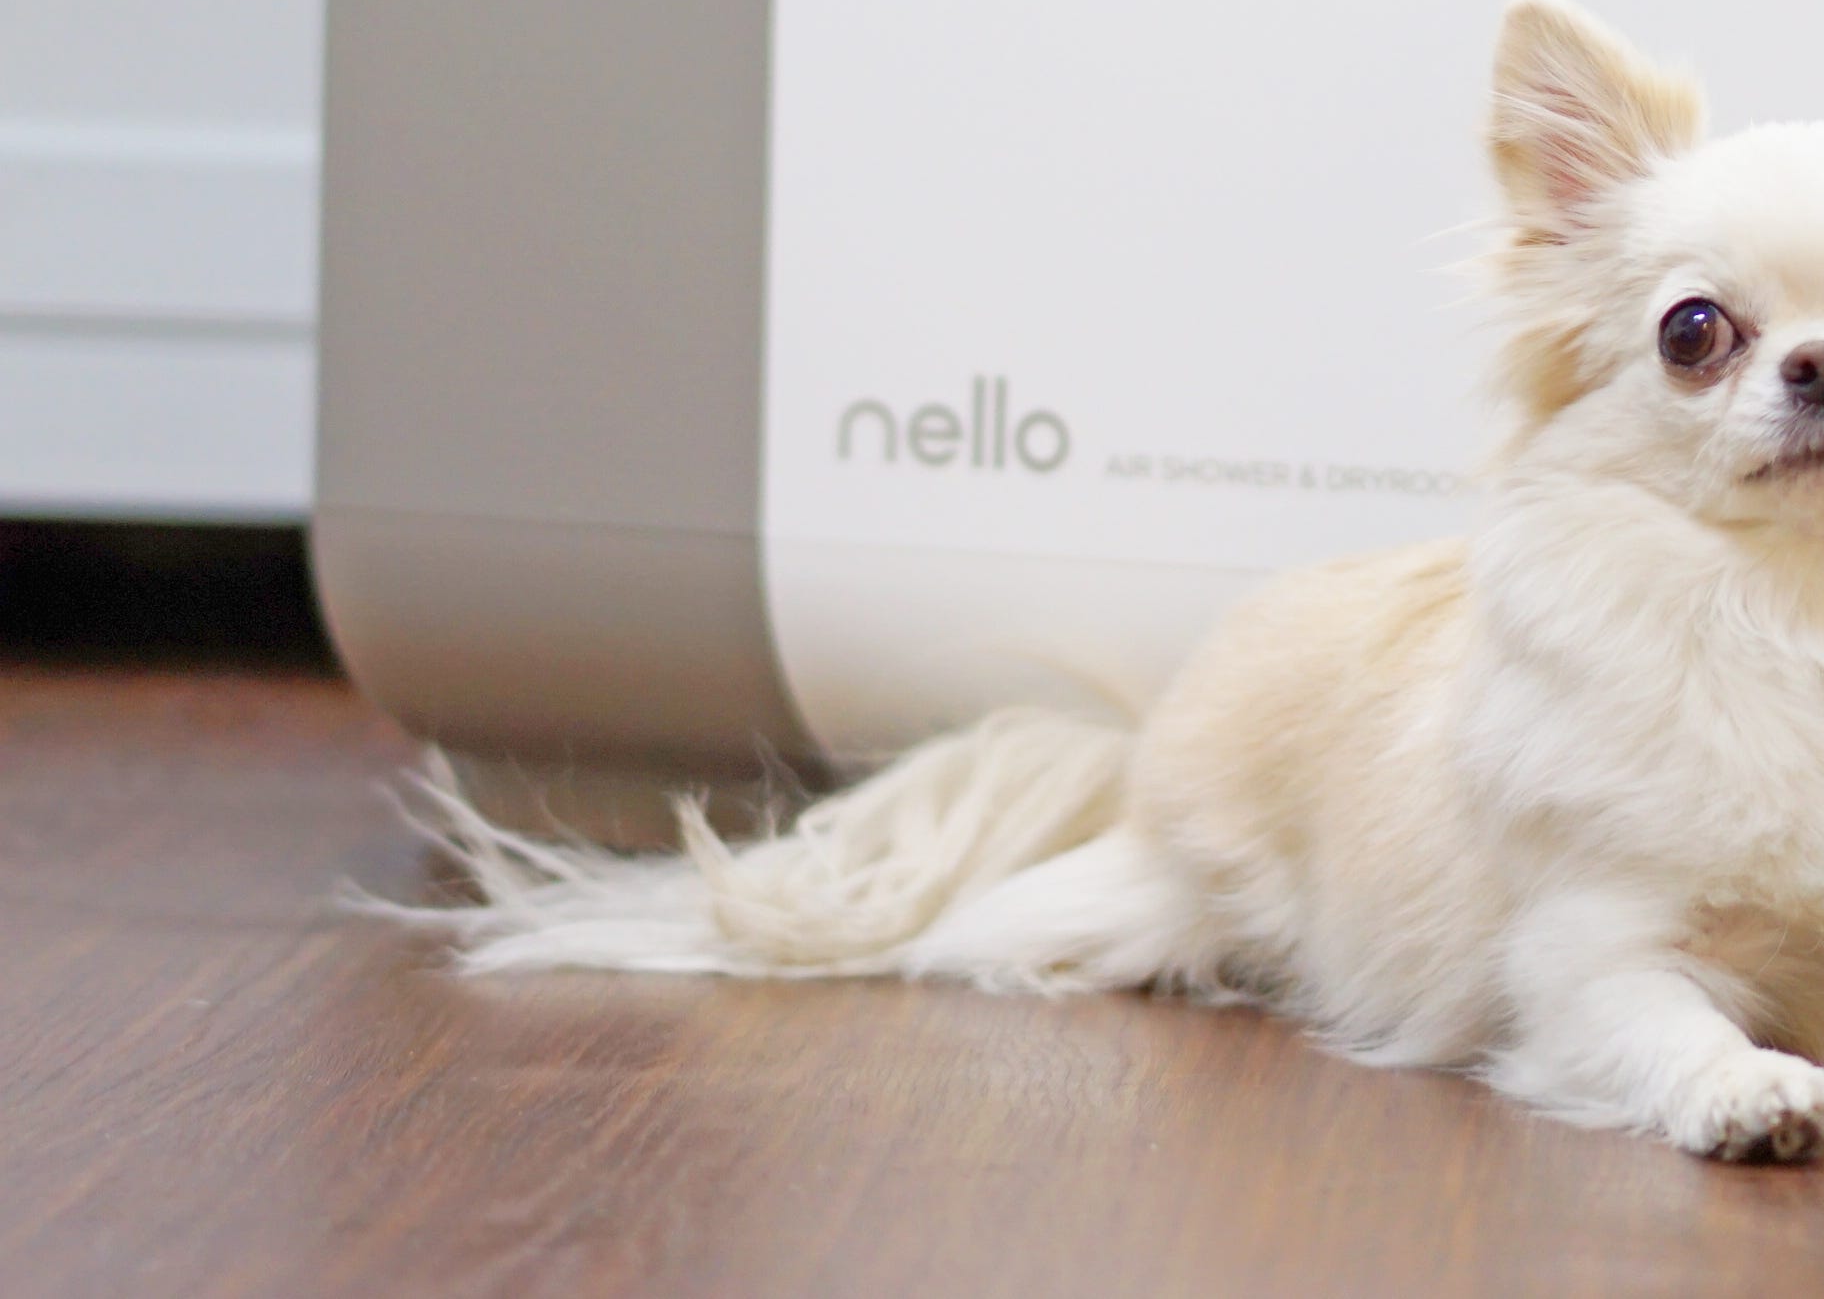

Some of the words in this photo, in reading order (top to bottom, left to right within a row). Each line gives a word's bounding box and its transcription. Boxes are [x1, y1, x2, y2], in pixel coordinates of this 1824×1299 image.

[837, 374, 1071, 474] nello
[1104, 453, 1155, 483] AIR
[1162, 455, 1293, 489] SHOWER
[1298, 463, 1318, 491] &
[1326, 465, 1475, 498] DRYROO
